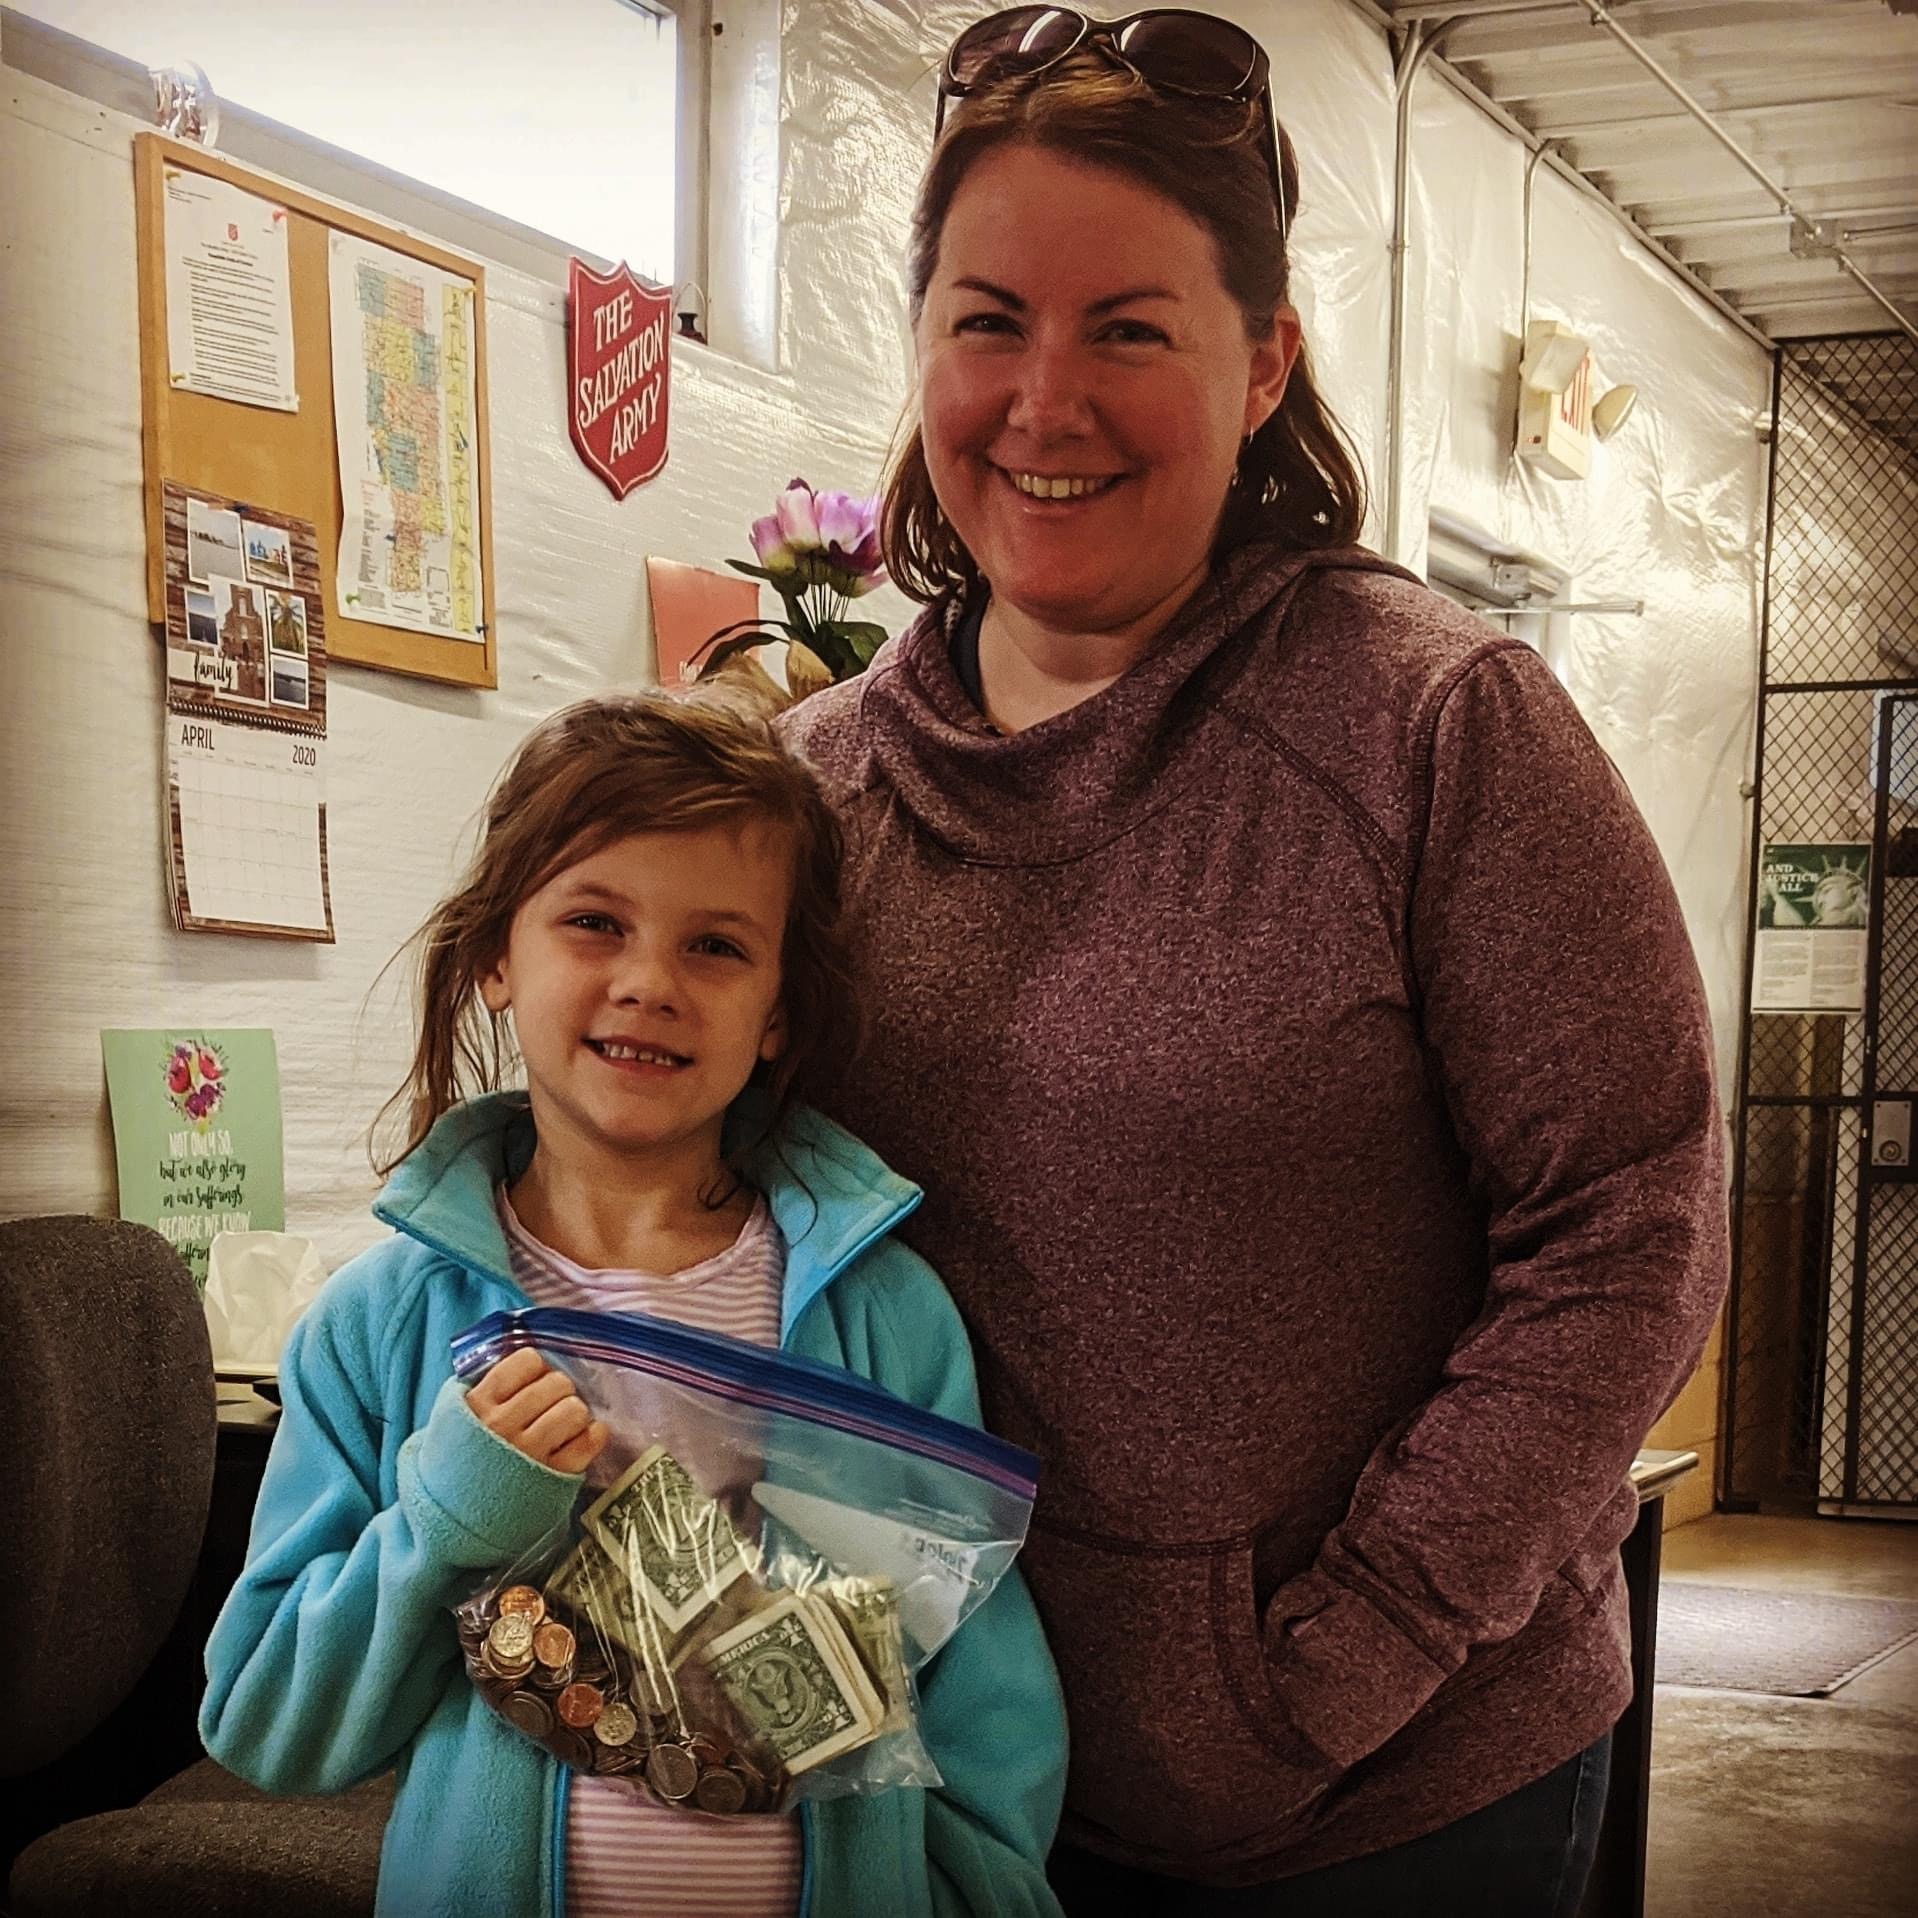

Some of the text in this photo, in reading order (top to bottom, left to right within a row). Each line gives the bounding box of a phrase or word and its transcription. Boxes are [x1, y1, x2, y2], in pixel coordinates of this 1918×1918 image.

[593, 289, 633, 352] THE
[579, 309, 665, 430] SALVATION
[609, 372, 662, 465] ARMY
[193, 651, 232, 690] family
[181, 723, 215, 751] APRIL
[292, 744, 316, 767] 2020
[1766, 863, 1794, 873] AND
[1779, 883, 1804, 892] ALL
